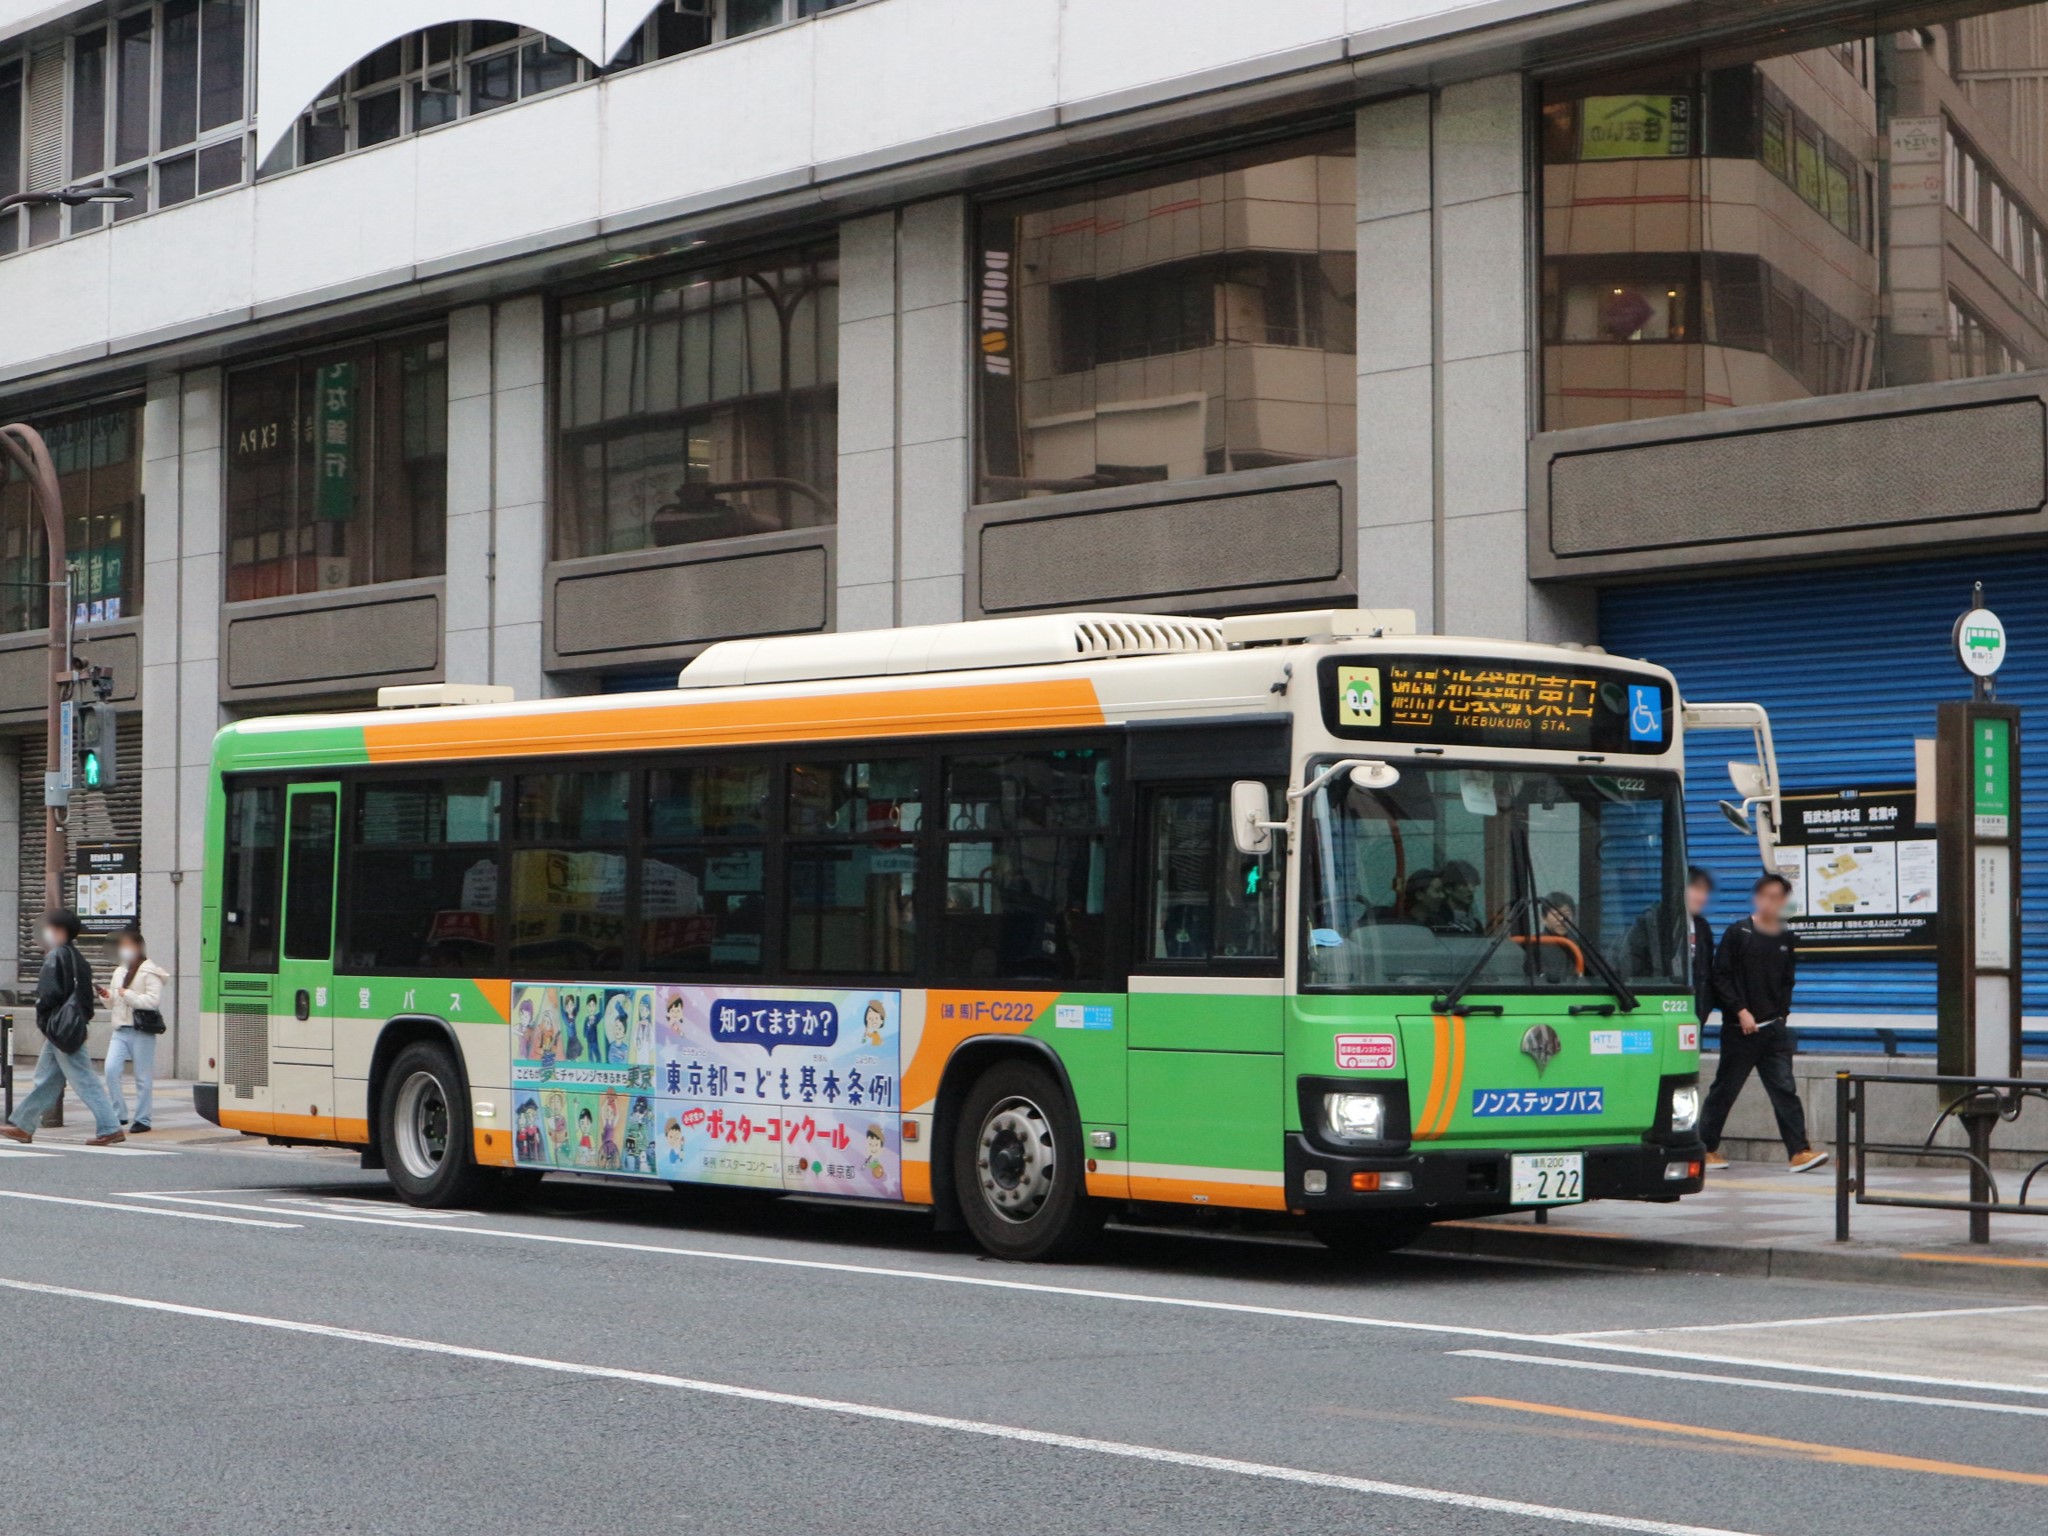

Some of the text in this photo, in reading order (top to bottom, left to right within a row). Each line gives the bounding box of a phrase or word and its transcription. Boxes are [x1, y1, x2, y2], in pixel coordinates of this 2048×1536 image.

[1437, 668, 1597, 718] 池袋駅東口
[1454, 714, 1572, 732] IKEBUKURO STA.
[1616, 778, 1646, 791] C222
[975, 1002, 1034, 1022] F-C222
[1662, 1000, 1689, 1012] C222
[719, 1006, 831, 1038] 知ってますか?
[1593, 1034, 1612, 1044] HTT
[665, 1060, 893, 1108] 東京都こども基本条例
[1473, 1091, 1603, 1114] ノンステップバス
[706, 1109, 851, 1150] ポスターコンクール
[826, 1164, 856, 1180] 東京都
